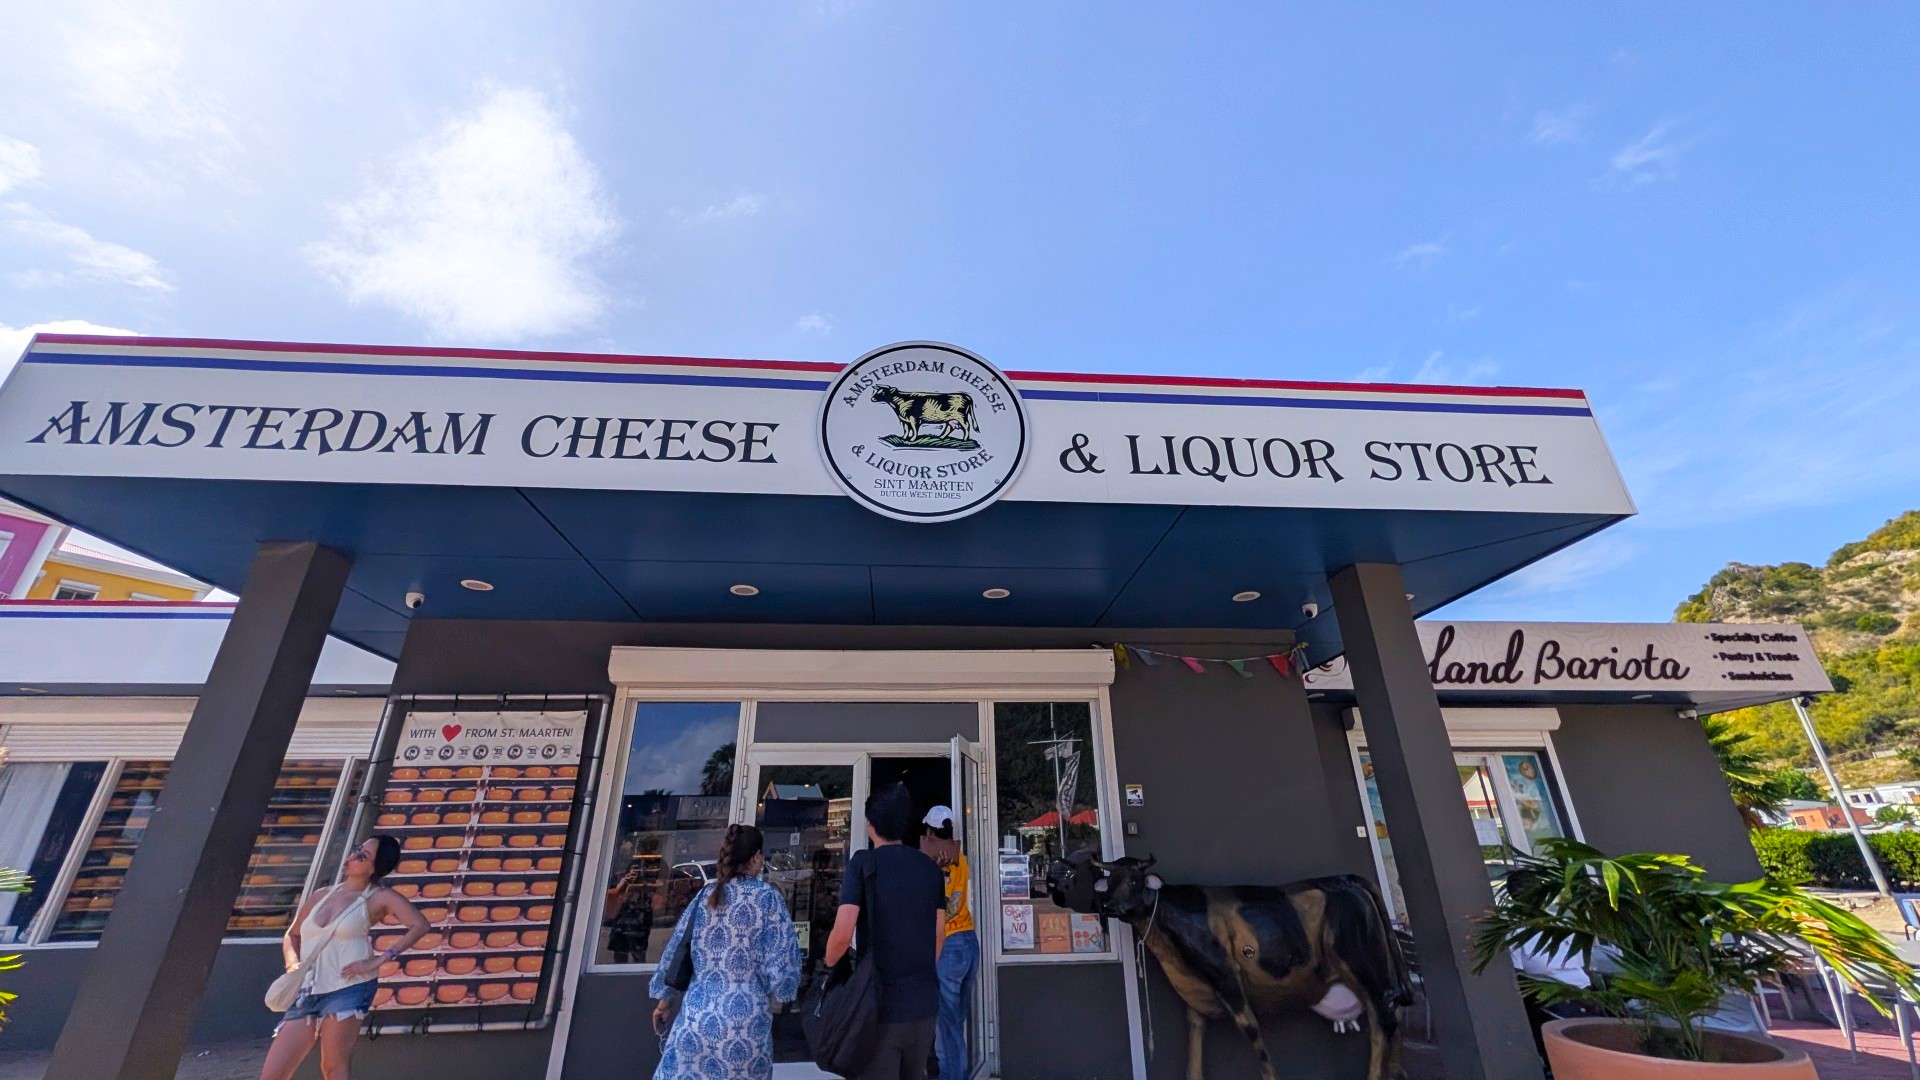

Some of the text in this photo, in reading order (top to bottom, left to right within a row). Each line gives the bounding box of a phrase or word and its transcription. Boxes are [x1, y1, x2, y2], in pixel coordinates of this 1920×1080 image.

[843, 360, 1007, 415] AMSTERDAM CHEESE
[26, 400, 780, 464] AMSTERDAM CHEESE
[851, 444, 995, 480] & LIQUOR STORE
[1059, 432, 1554, 488] & LIQUOR STORE
[874, 479, 974, 492] SINT MAARTEN
[880, 490, 962, 500] DUTCH WEST INDIES
[1710, 632, 1798, 644] Specialty Coffee
[1429, 624, 1524, 685] land
[1718, 652, 1754, 663] Pastry
[1763, 652, 1800, 662] Treats
[1727, 671, 1794, 681] Sandwiches
[410, 728, 574, 739] WITH FROM ST. MAARTEN!
[1010, 922, 1028, 934] NO
